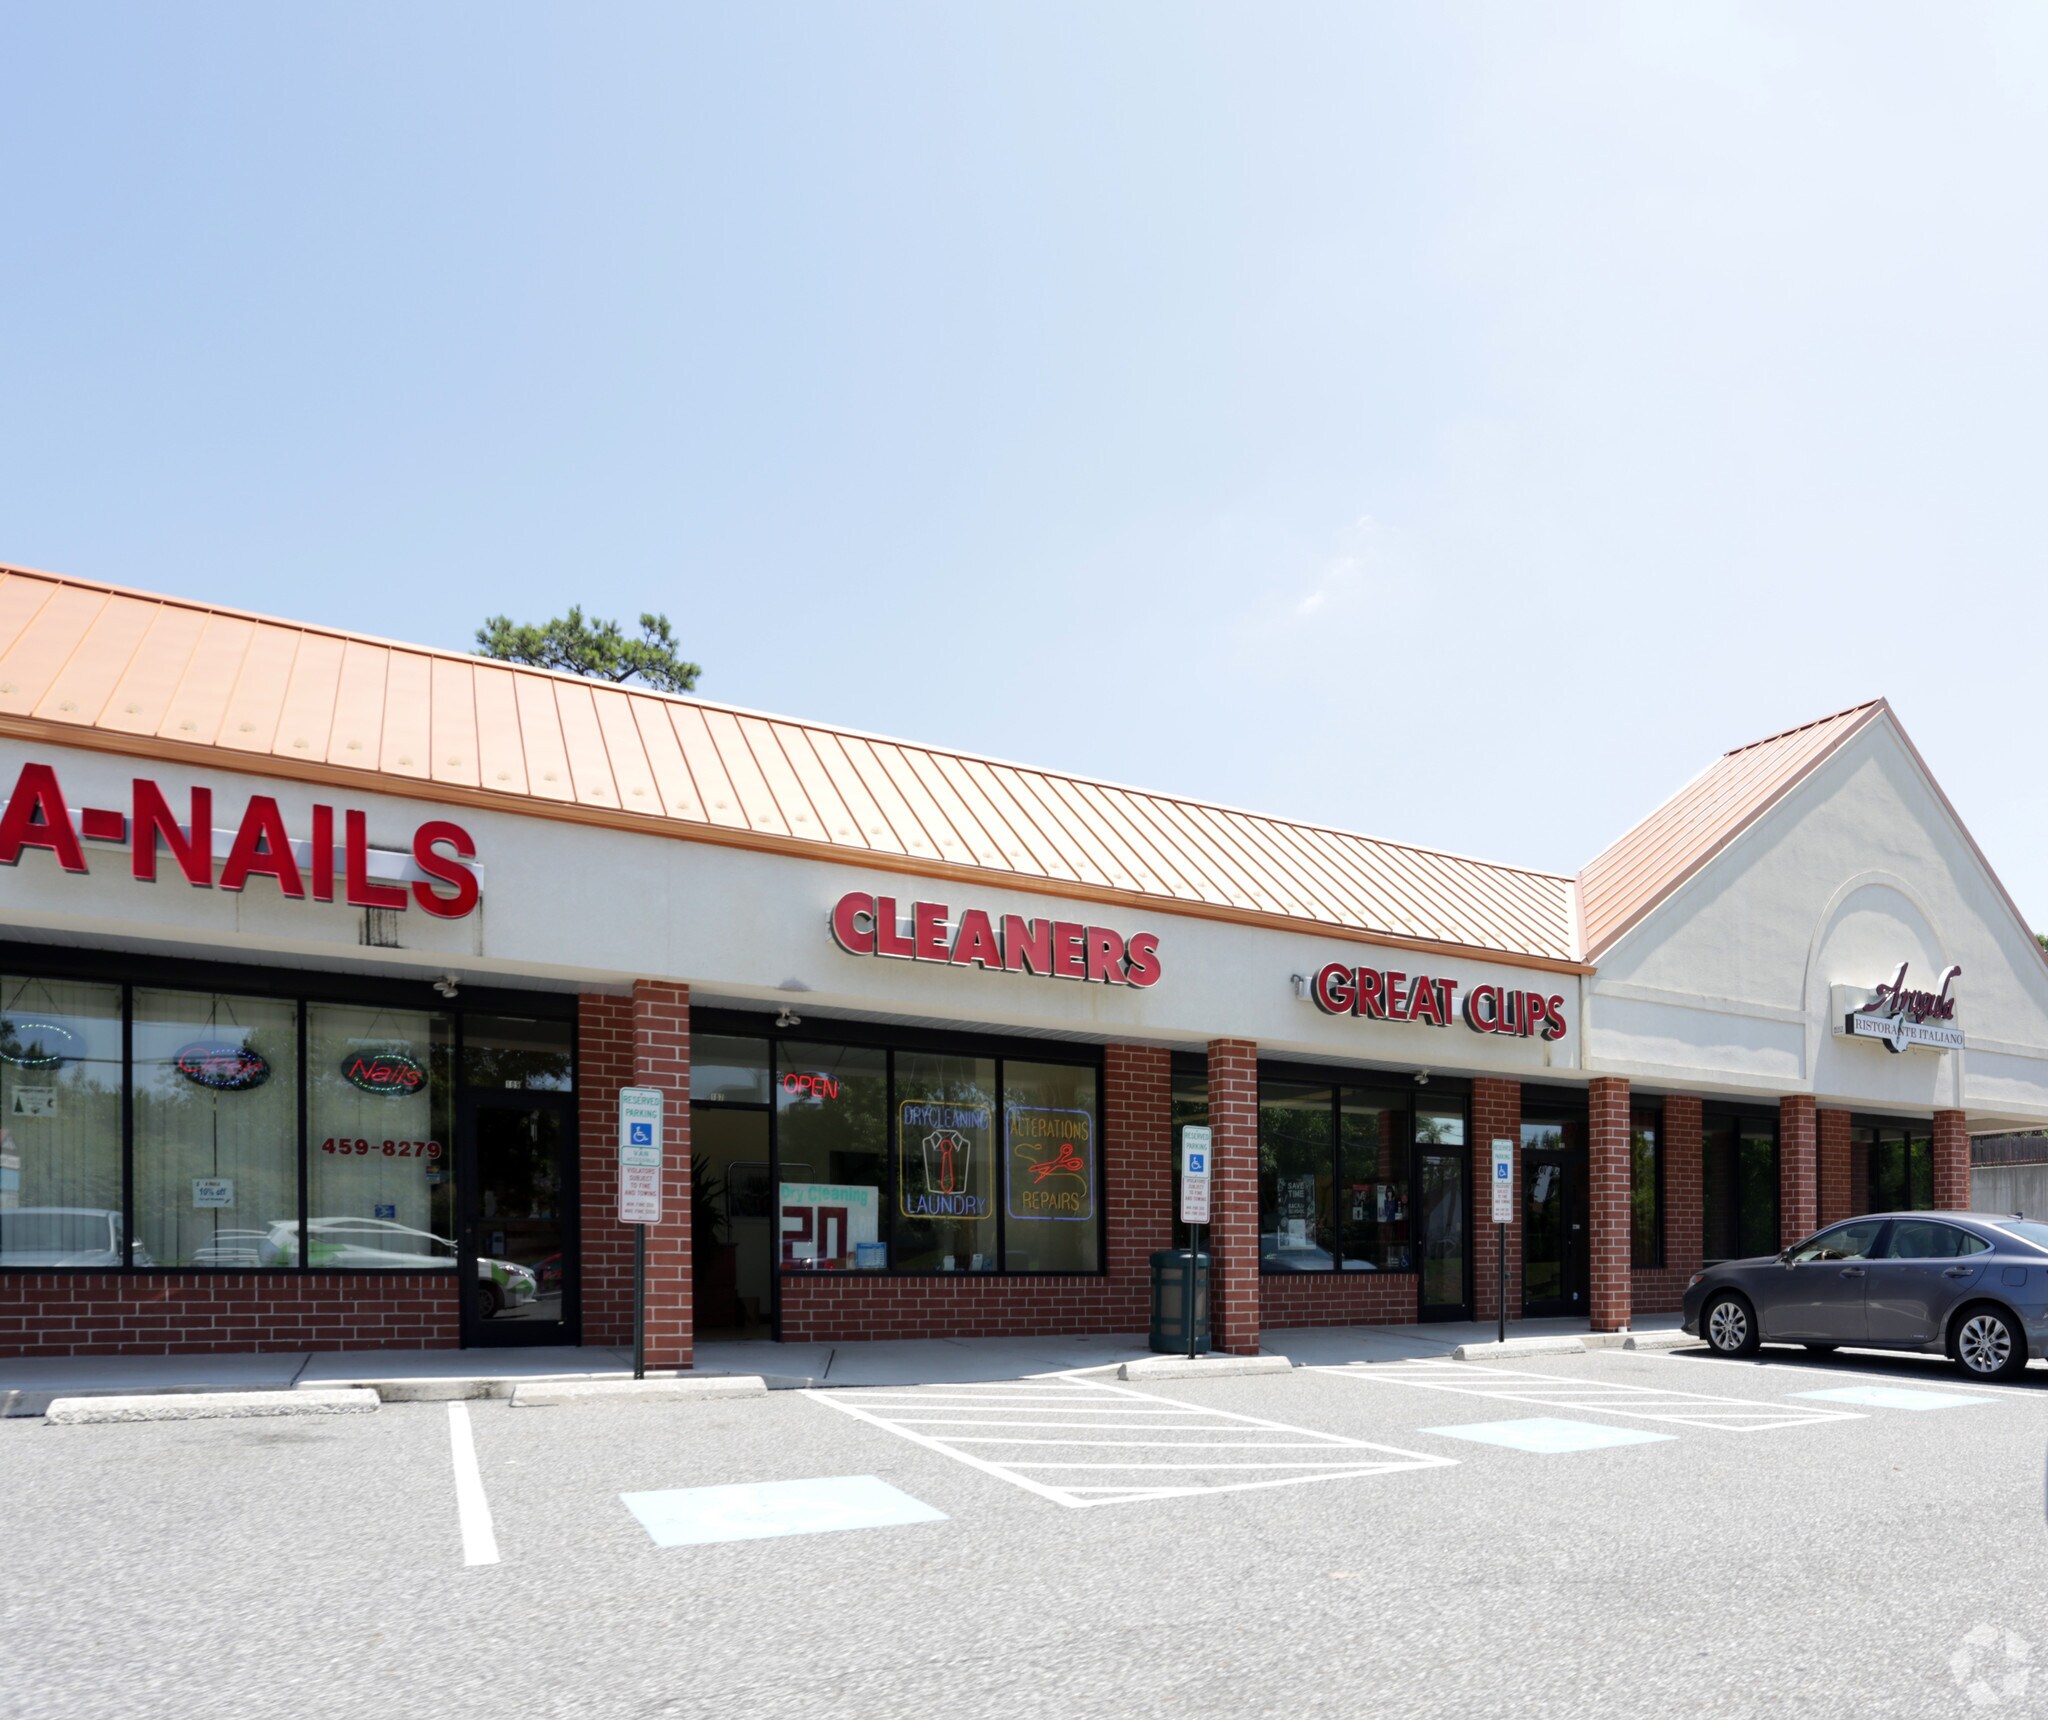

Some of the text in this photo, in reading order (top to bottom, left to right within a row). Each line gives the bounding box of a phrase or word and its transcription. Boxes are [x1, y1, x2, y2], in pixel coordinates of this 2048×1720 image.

[0, 762, 478, 918] A-NAILS
[832, 891, 1162, 988] CLEANERS
[1311, 962, 1567, 1041] GREAT CLIPS
[1855, 1018, 1917, 1039] RISTORANTE
[1919, 1029, 1964, 1046] ITALIANO
[179, 1047, 263, 1078] Open
[348, 1058, 423, 1087] Nails
[783, 1073, 839, 1100] OPEN
[622, 1095, 660, 1106] RESERVED
[626, 1108, 657, 1119] PARKING
[903, 1105, 989, 1131] DRYCLEANING
[1009, 1117, 1089, 1141] ALTERATIONS
[1184, 1132, 1209, 1141] RESERVED
[320, 1137, 442, 1161] 459-8279
[1186, 1142, 1208, 1151] PARKING
[639, 1182, 652, 1190] FINE
[781, 1185, 868, 1207] Dry Cleaning
[1287, 1182, 1305, 1190] SAVE
[1287, 1190, 1305, 1198] TIME
[906, 1193, 986, 1216] LAUNDRY
[1022, 1191, 1081, 1211] REPAIRS
[782, 1206, 848, 1270] 20
